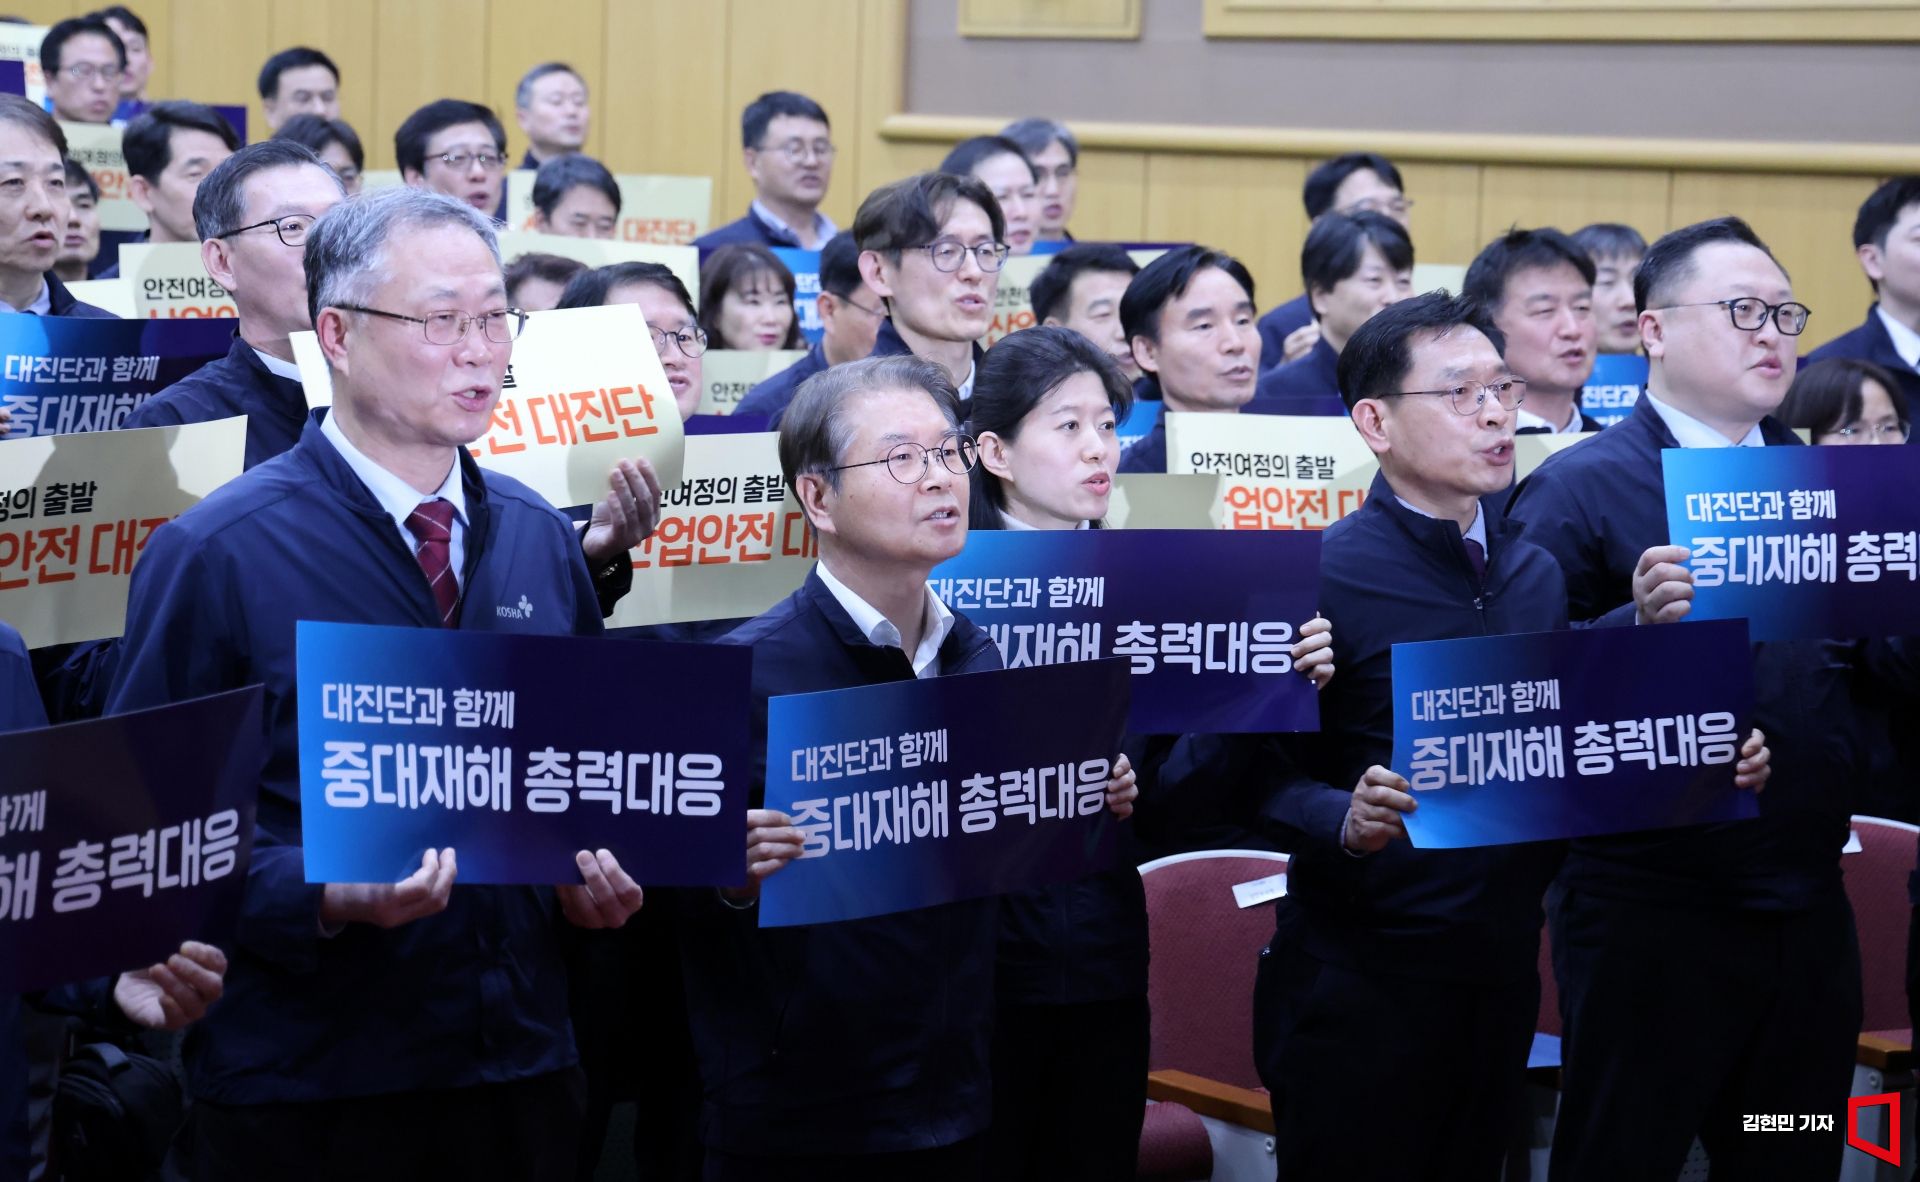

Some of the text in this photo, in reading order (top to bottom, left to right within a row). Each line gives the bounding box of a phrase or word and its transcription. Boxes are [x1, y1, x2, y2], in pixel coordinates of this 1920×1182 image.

[144, 277, 231, 300] 안전여정
[5, 355, 160, 383] 대진단과 함께
[711, 383, 756, 402] 안전
[472, 384, 659, 456] 전 대진단
[1191, 452, 1335, 480] 안전여정의 출발
[43, 480, 98, 517] 출발
[660, 476, 738, 508] 여정의
[1223, 486, 1329, 531] 업안전
[1686, 489, 1837, 523] 대진단과 함께
[1690, 530, 1920, 588] 중대재해 총력
[496, 605, 524, 620] KOSHA
[926, 576, 1105, 609] 대진단과 함께
[1112, 620, 1296, 675] 총력대응
[322, 683, 515, 729] 대진단과 함께
[1411, 678, 1561, 722] 대진단과 함께
[791, 728, 948, 783] 대진단과 함께
[1410, 711, 1739, 792] 중대재해 총력대응
[321, 740, 725, 817] 중대재해 총력대응
[790, 757, 1110, 861] 중대재해 총력대응
[52, 808, 240, 913] 총력대응
